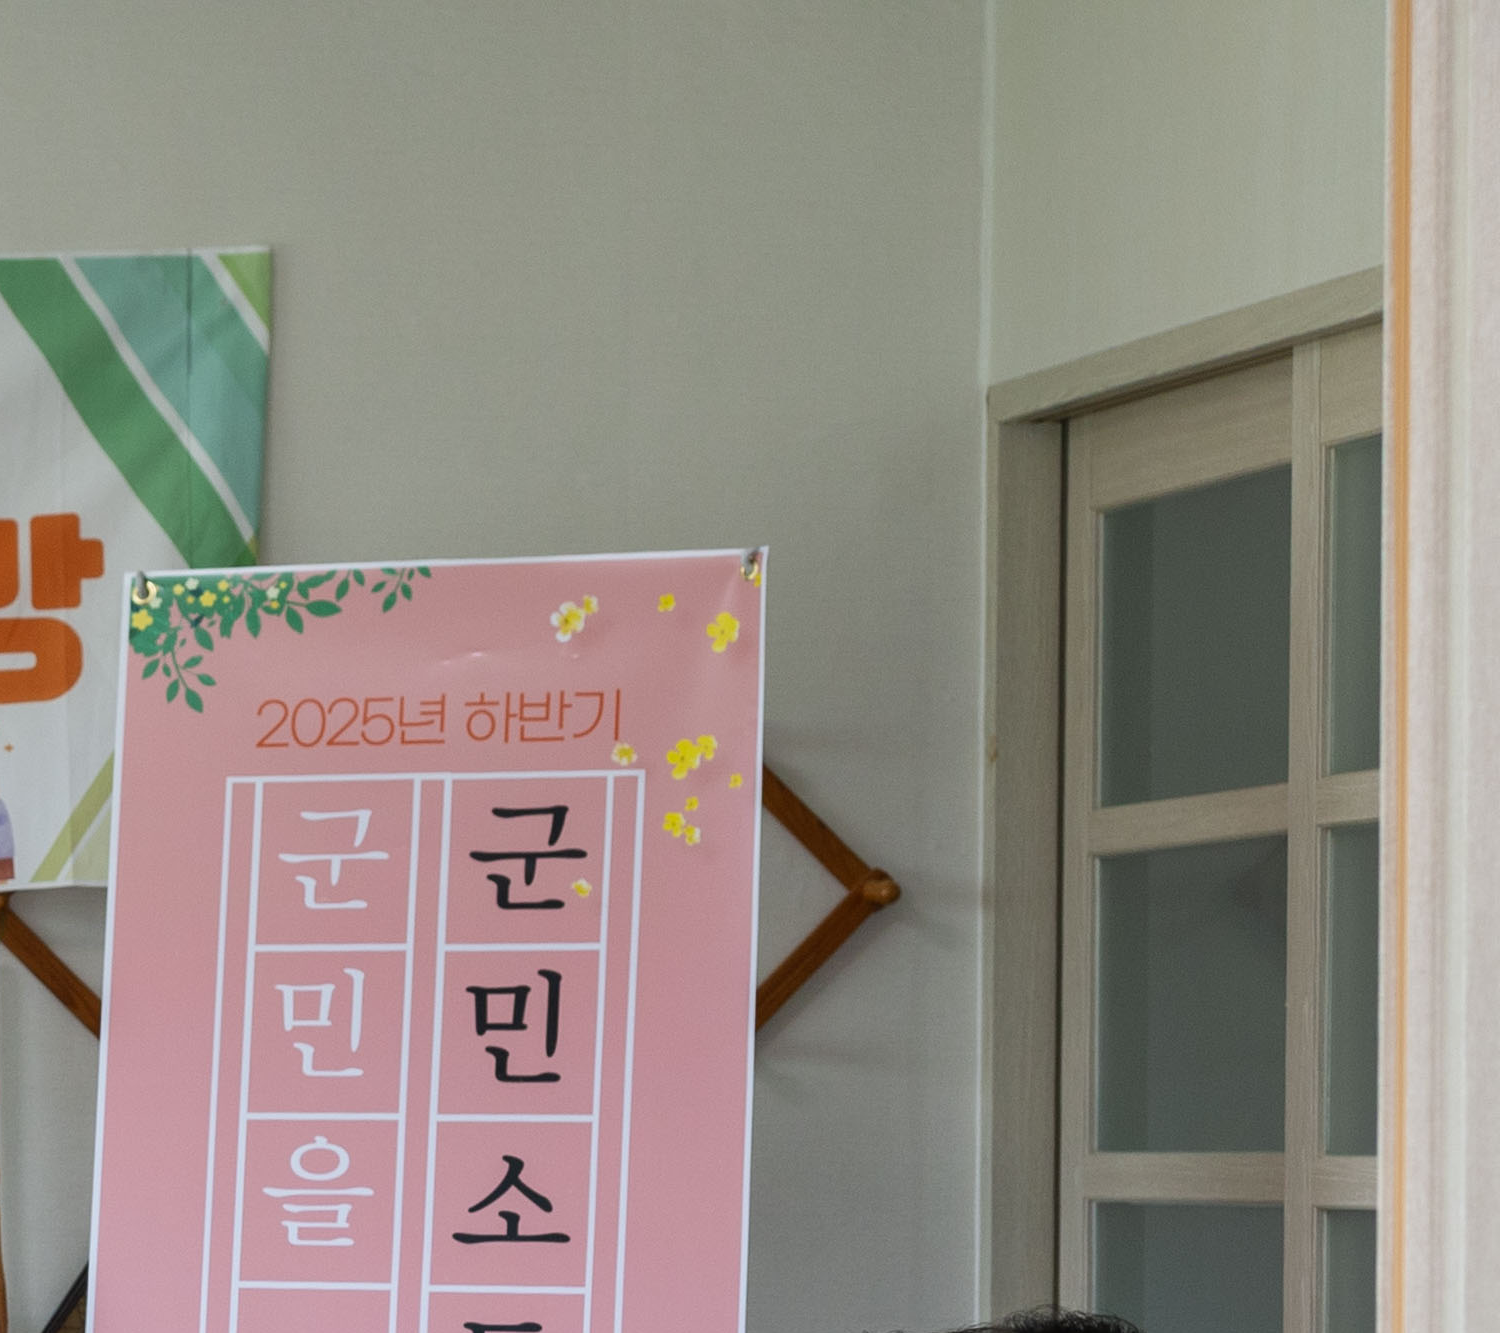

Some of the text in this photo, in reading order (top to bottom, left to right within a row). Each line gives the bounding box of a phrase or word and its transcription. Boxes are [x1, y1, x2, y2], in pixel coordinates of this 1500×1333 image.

[255, 688, 624, 749] 2025년 하반기
[260, 804, 394, 1250] 군민을
